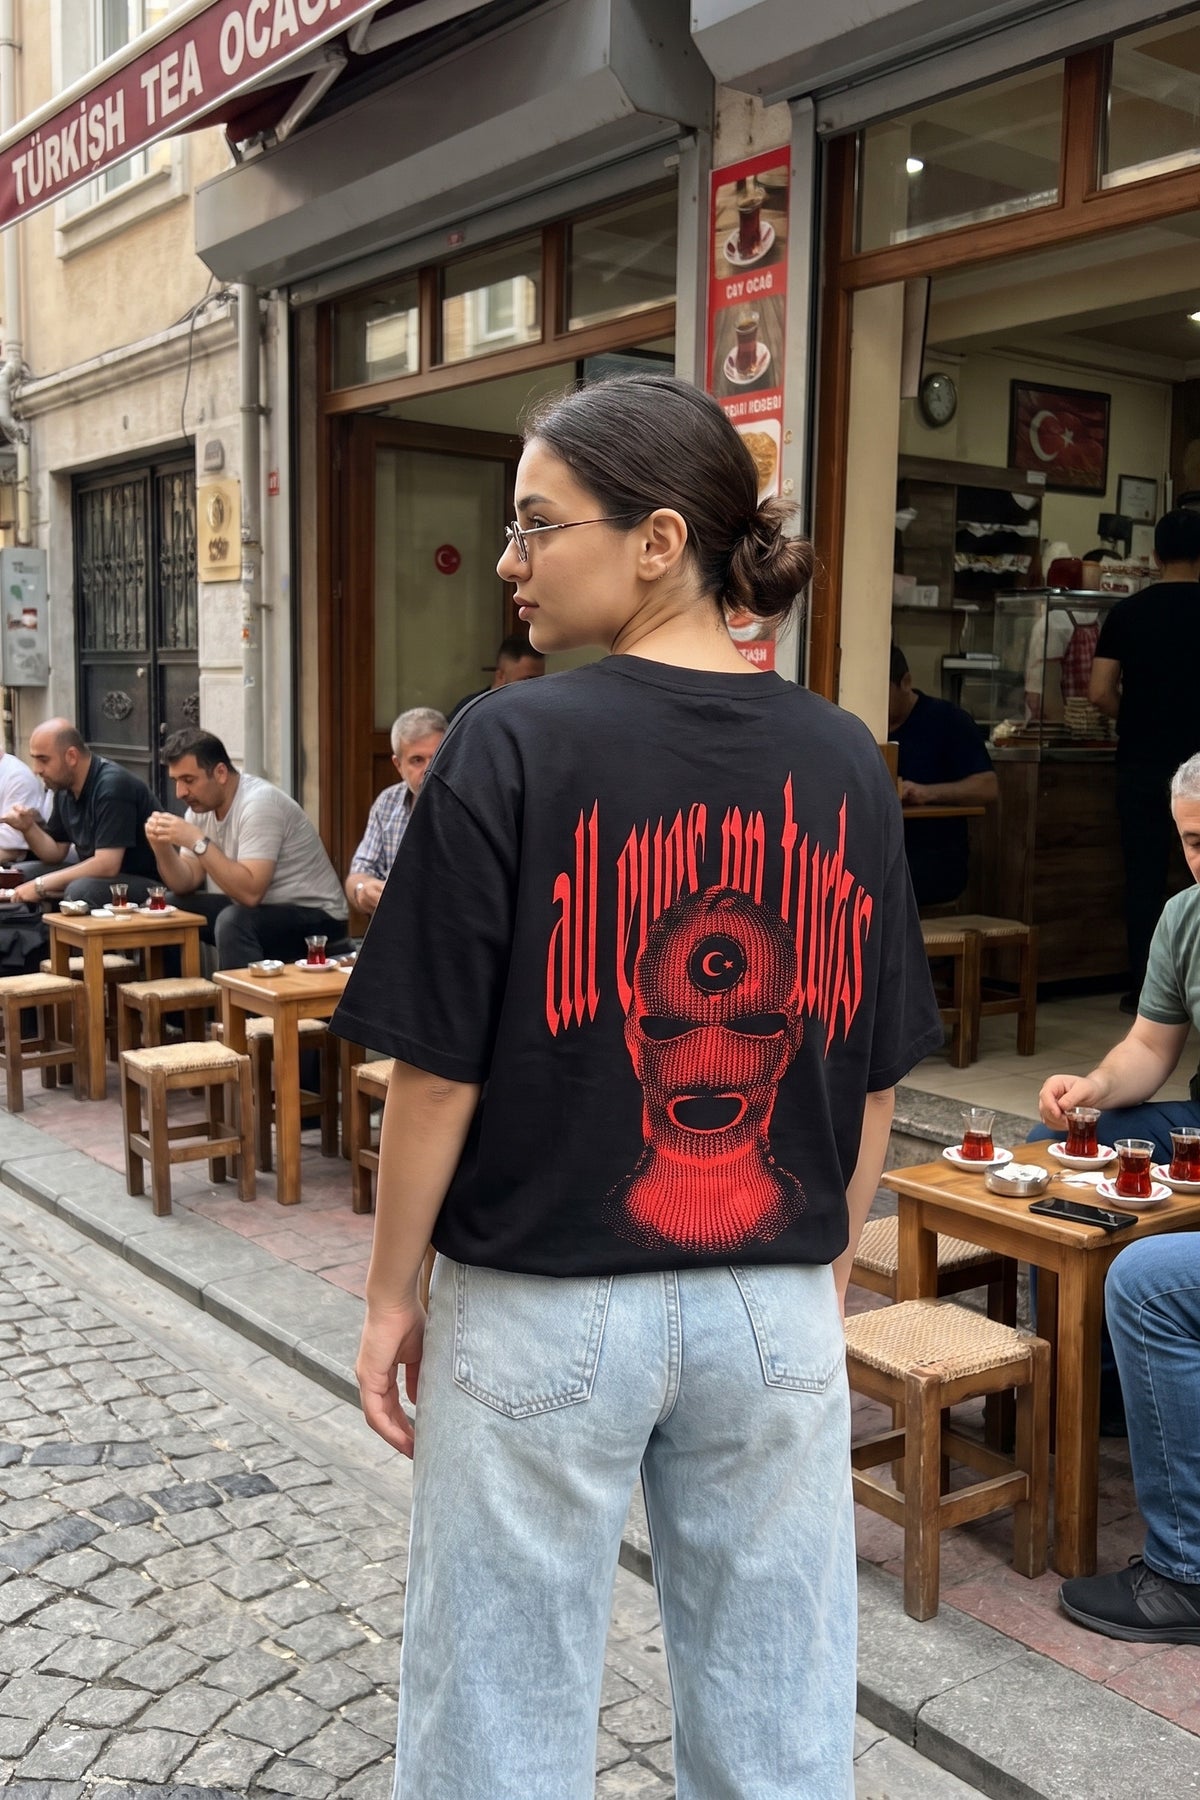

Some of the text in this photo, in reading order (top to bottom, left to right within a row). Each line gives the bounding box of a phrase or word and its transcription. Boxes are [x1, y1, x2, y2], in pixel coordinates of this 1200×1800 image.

[141, 40, 203, 126] TEA
[544, 798, 601, 1038] all
[780, 770, 874, 1061] turks
